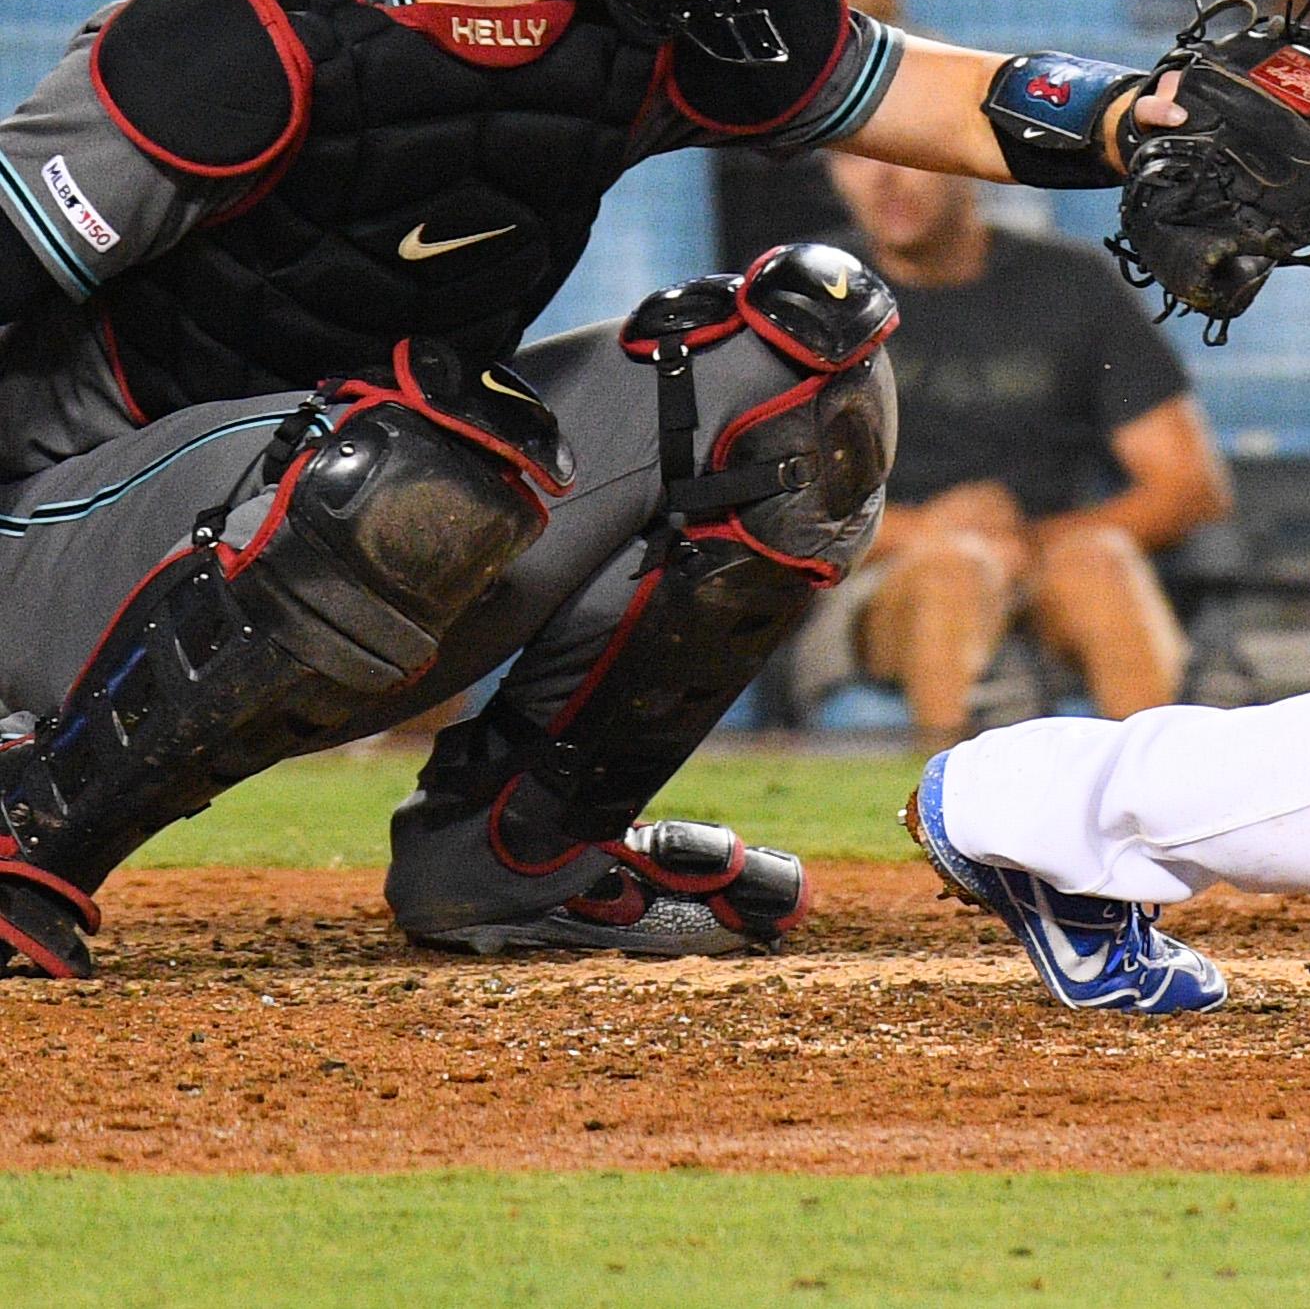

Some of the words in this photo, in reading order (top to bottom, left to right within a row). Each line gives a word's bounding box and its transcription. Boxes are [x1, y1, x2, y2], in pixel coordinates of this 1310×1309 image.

[451, 16, 548, 46] KELLY
[46, 162, 72, 200] MLB
[84, 219, 111, 246] 150
